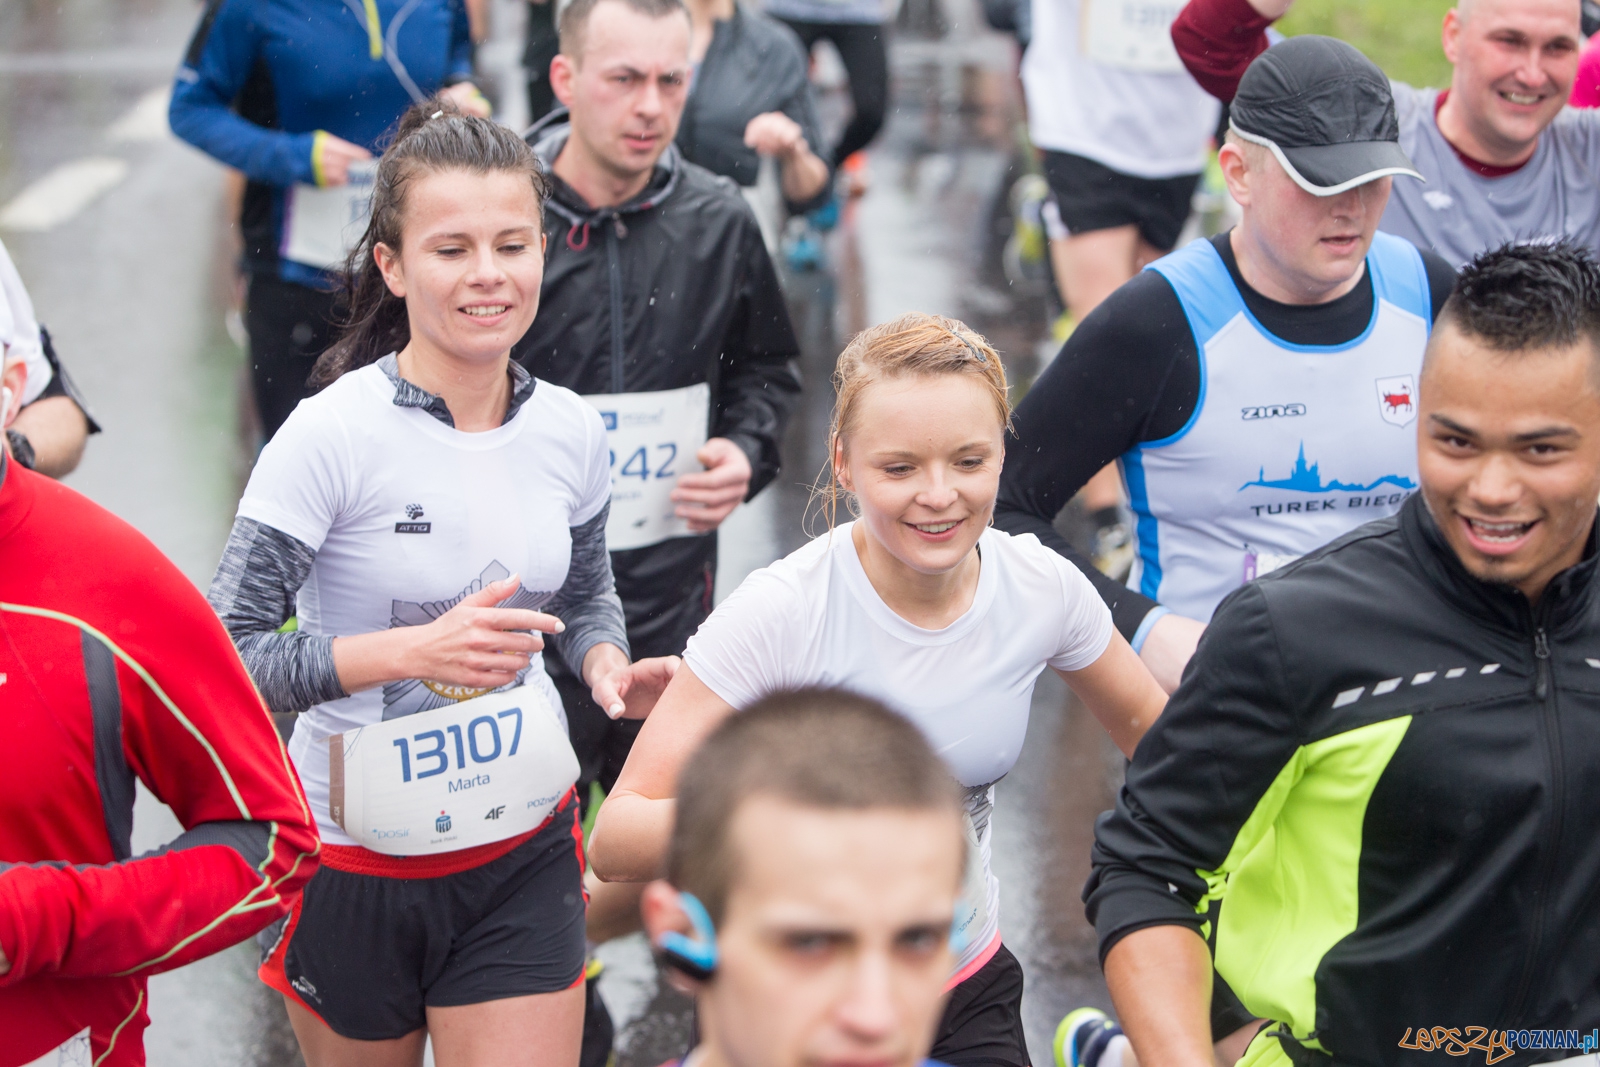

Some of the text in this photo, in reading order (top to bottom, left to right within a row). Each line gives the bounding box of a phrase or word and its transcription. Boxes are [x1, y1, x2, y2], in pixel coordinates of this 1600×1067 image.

[1250, 499, 1337, 517] TUREK
[393, 707, 523, 783] 13107
[448, 774, 490, 794] Marta
